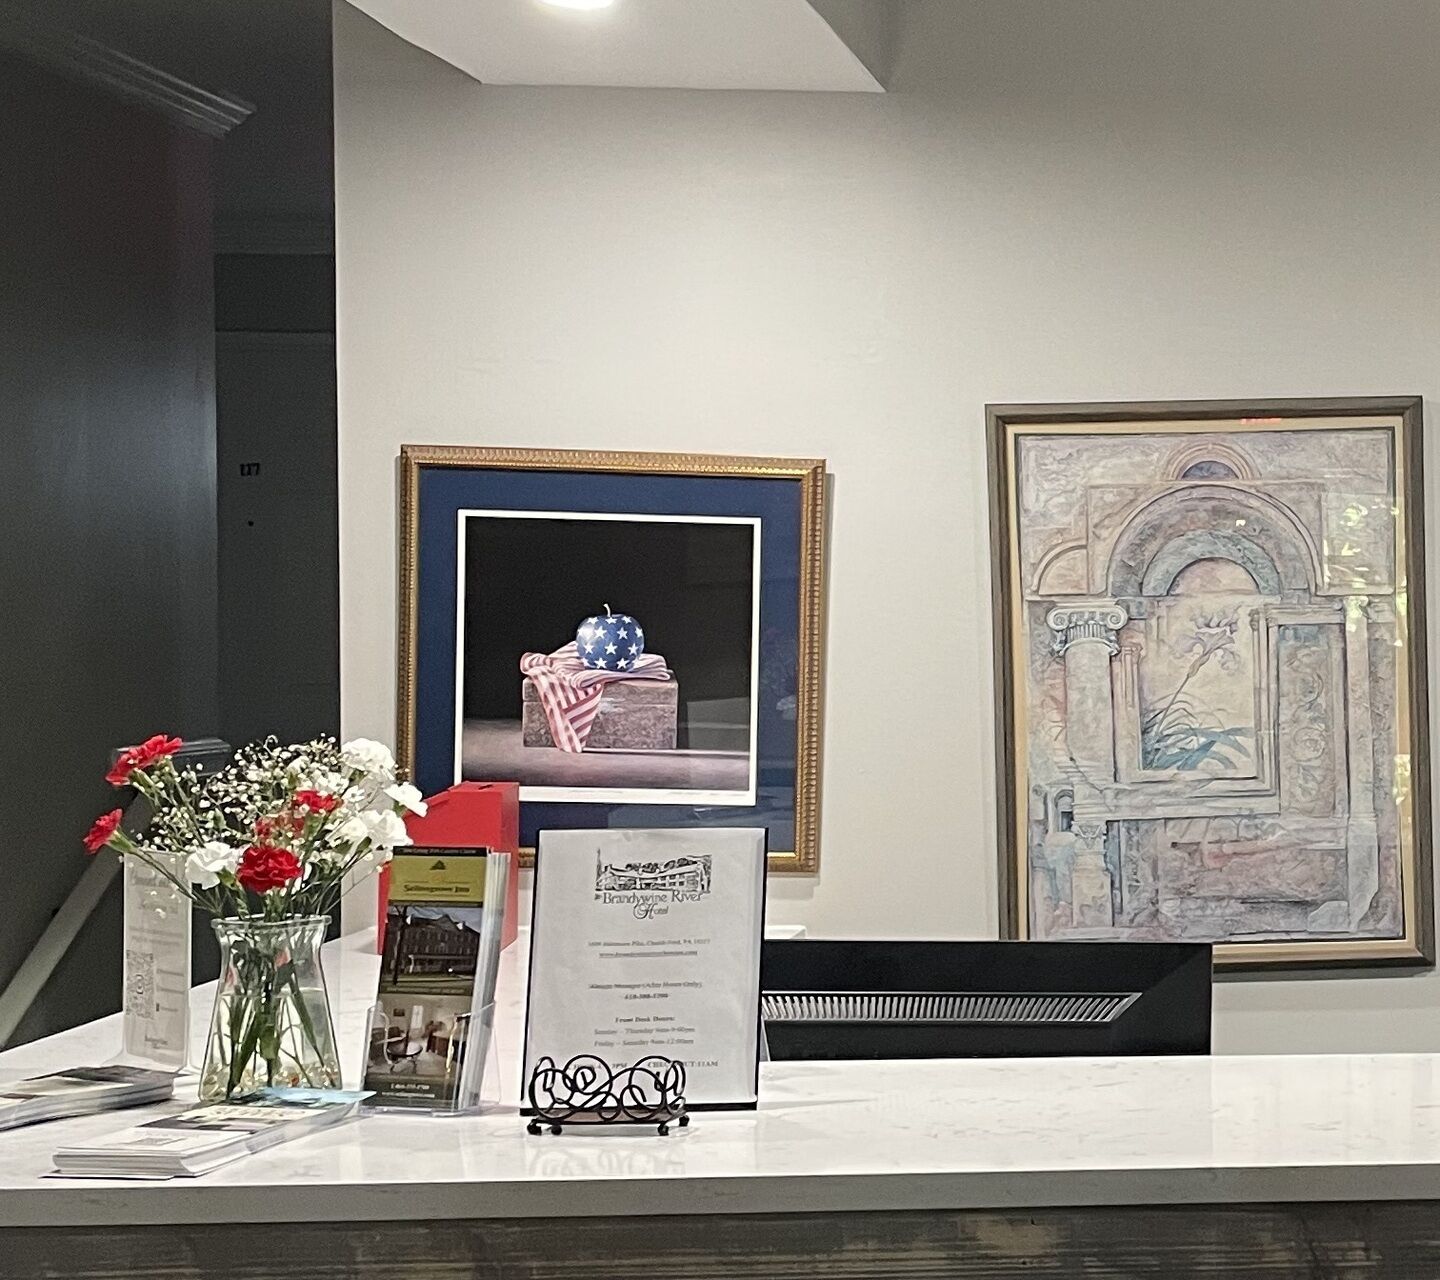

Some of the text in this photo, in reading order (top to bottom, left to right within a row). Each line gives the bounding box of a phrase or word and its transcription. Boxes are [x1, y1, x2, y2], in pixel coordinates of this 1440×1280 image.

[603, 892, 668, 910] Brandywine
[672, 889, 702, 903] River
[633, 903, 669, 920] Hotel
